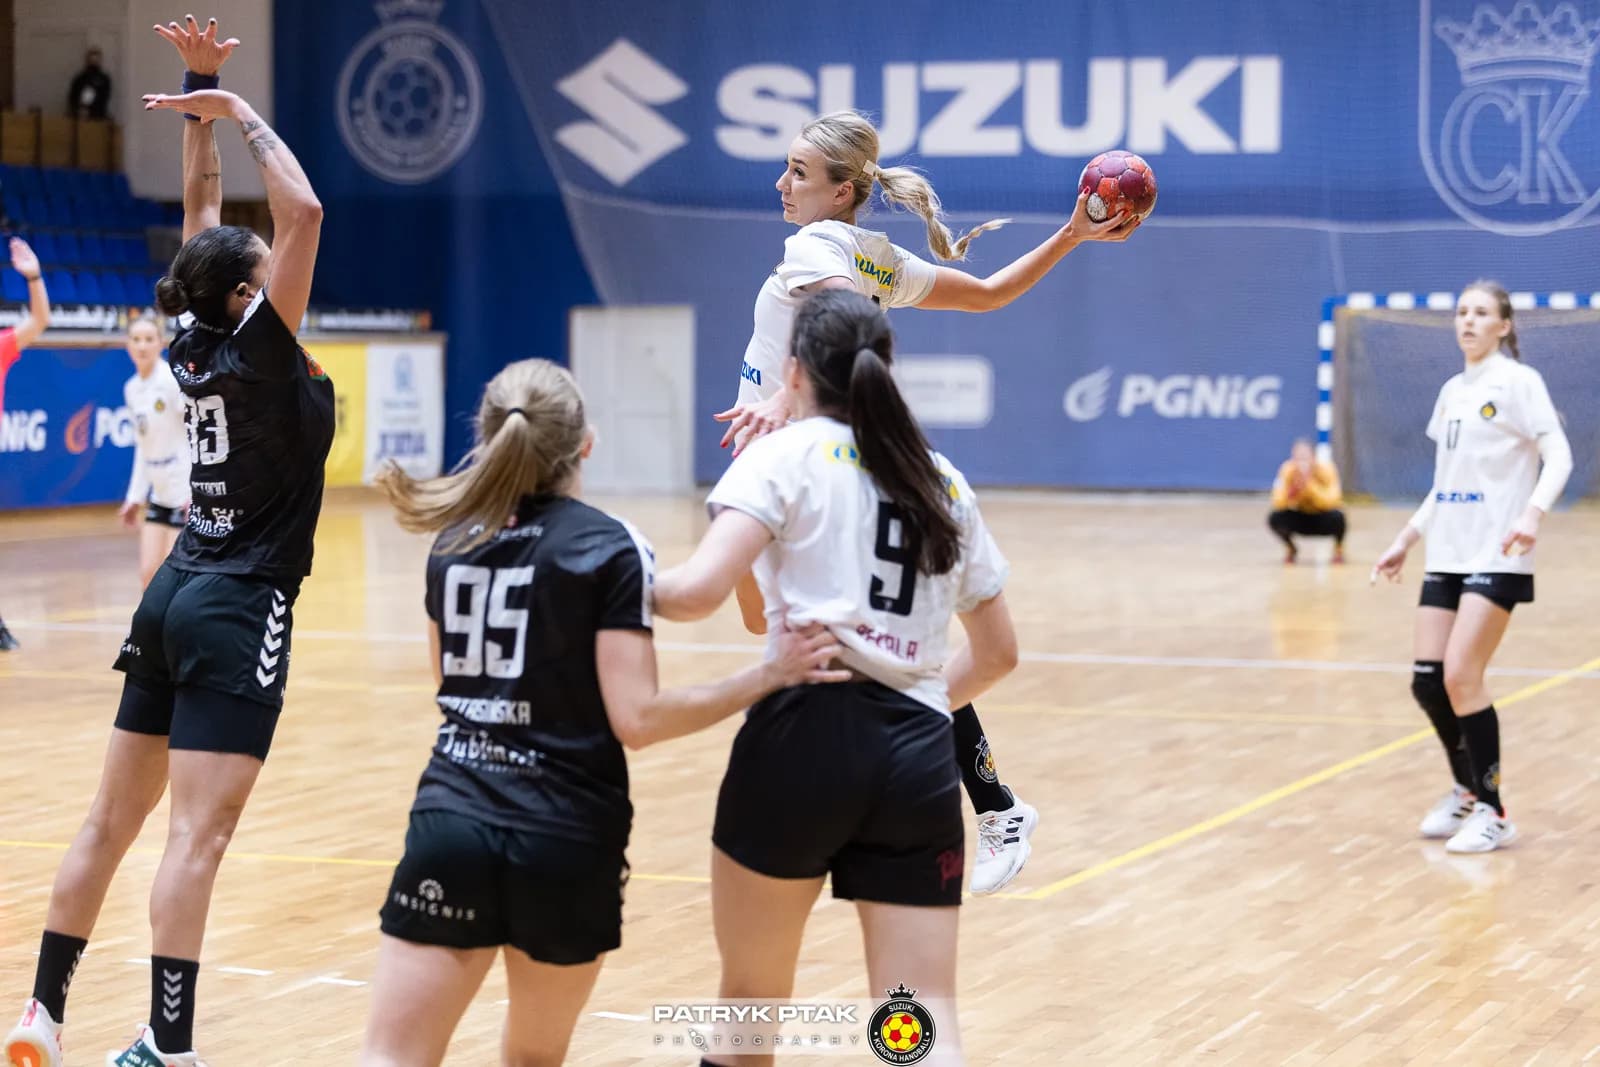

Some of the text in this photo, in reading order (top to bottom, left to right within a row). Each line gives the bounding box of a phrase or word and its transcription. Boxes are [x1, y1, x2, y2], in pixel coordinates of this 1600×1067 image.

[715, 56, 1281, 160] SUZUKI
[1116, 374, 1281, 419] PGNiG
[869, 500, 916, 616] 9
[443, 564, 535, 679] 95
